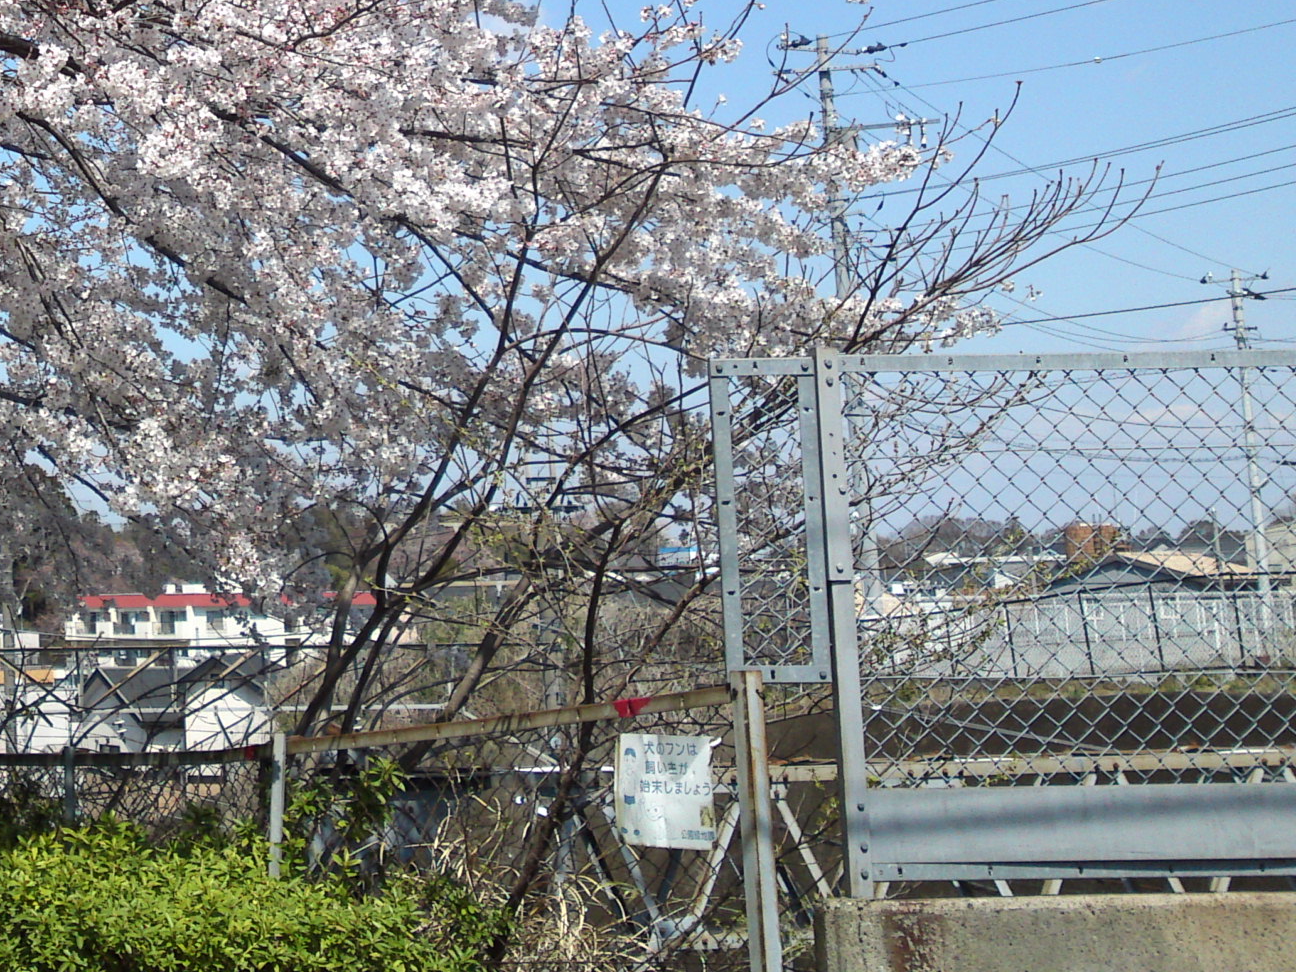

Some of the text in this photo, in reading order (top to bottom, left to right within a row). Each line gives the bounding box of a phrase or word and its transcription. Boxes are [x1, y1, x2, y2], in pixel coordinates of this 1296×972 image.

[644, 741, 698, 756] 犬のフンは
[639, 780, 711, 796] 始末しましょう
